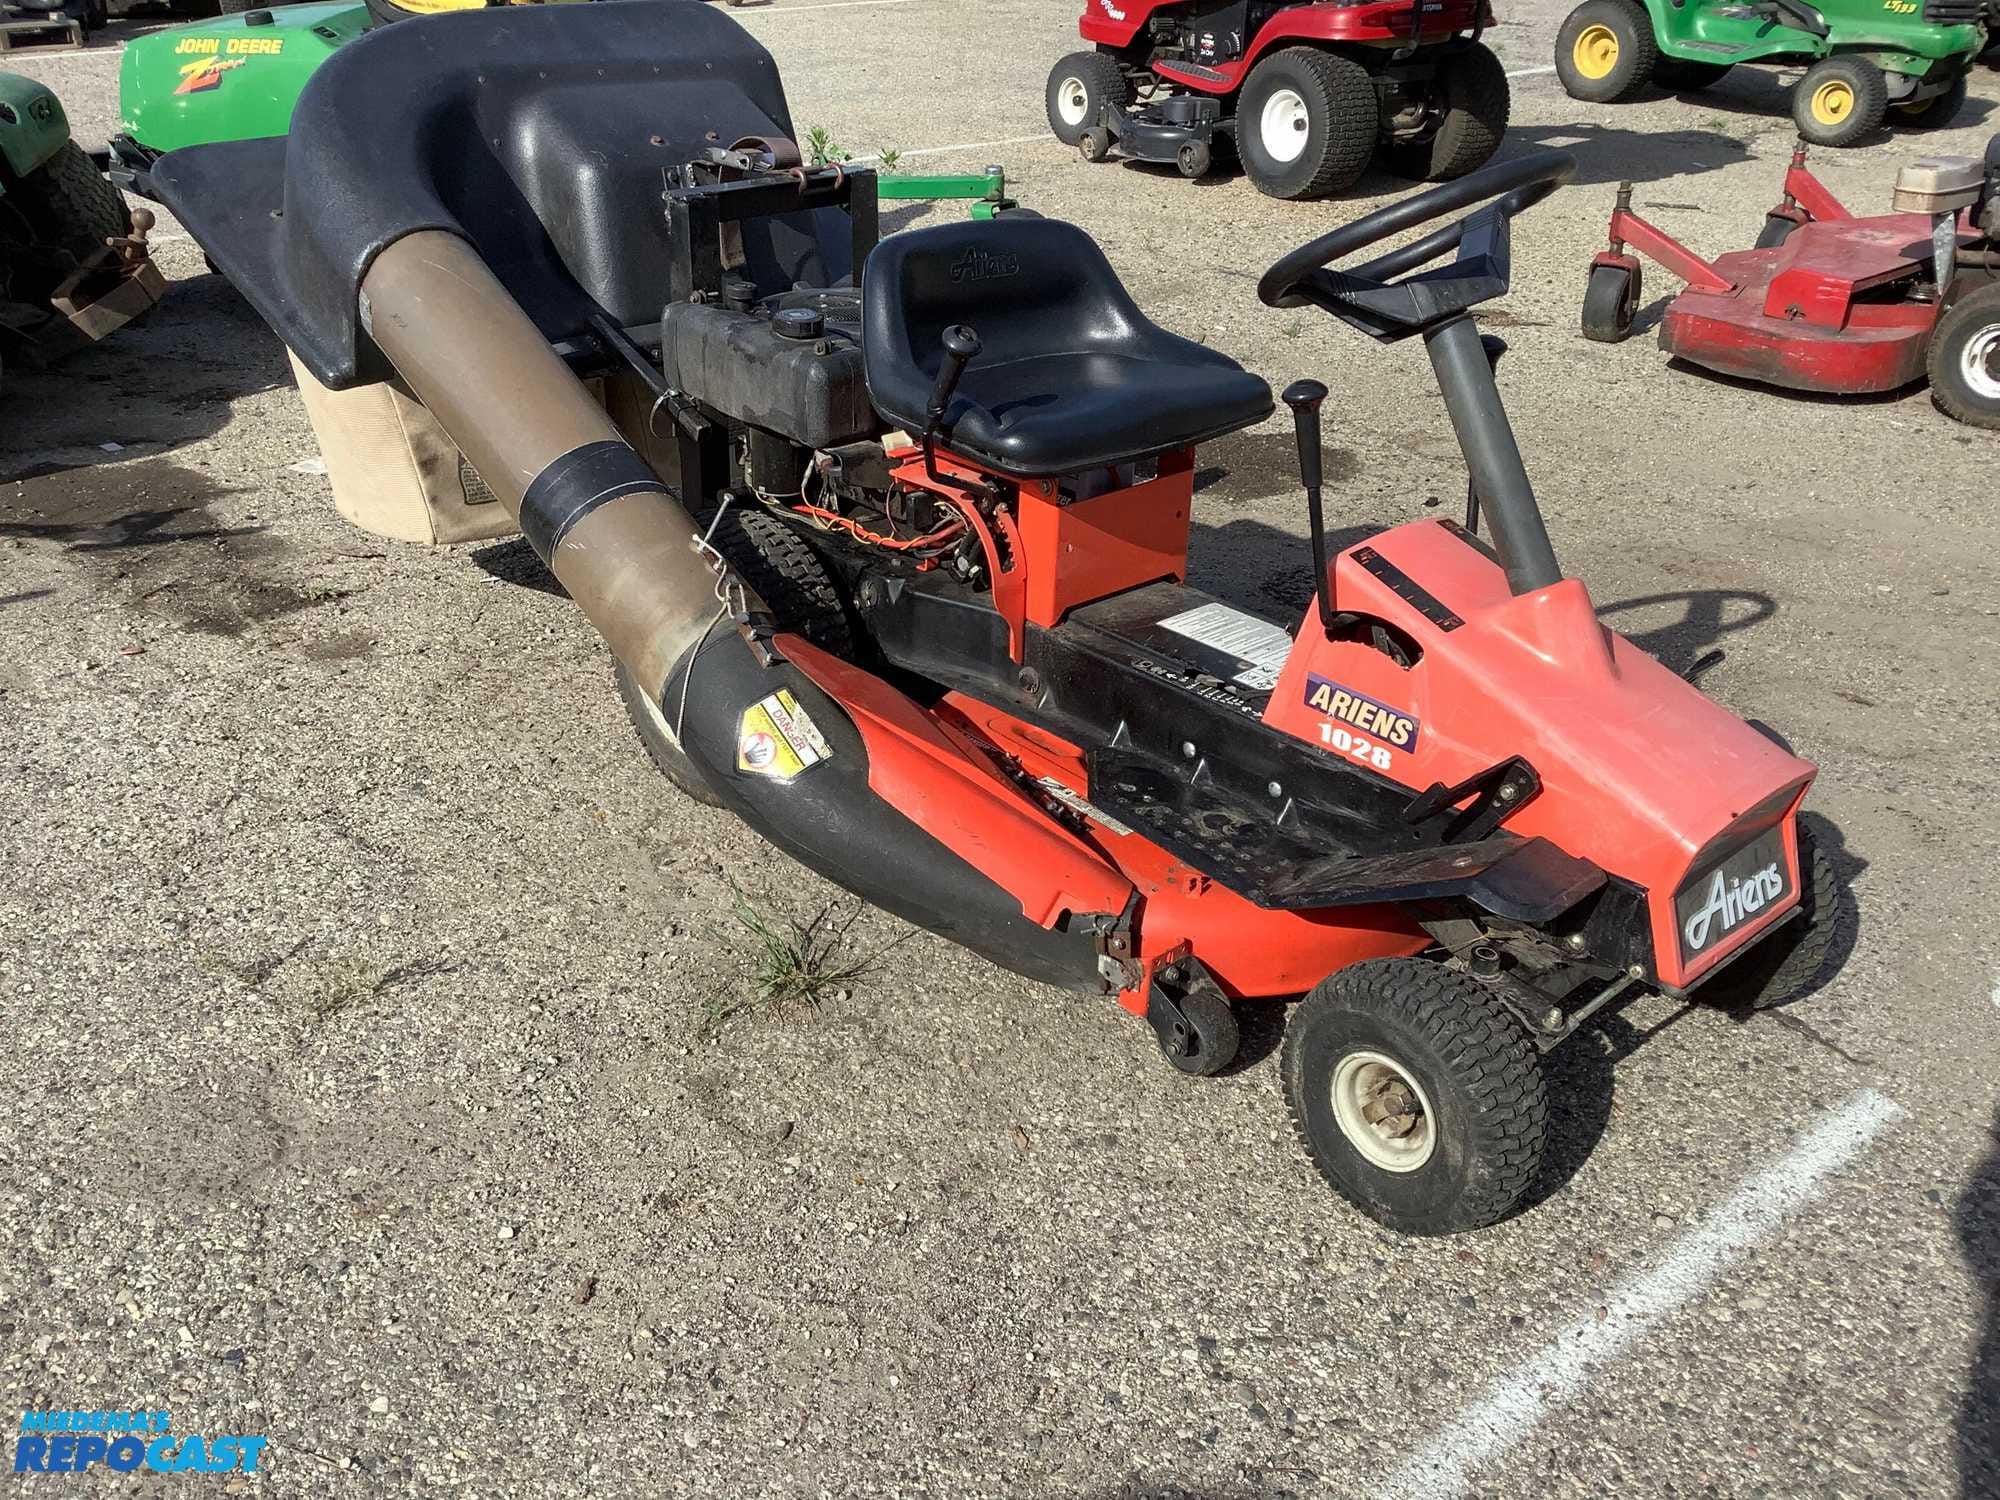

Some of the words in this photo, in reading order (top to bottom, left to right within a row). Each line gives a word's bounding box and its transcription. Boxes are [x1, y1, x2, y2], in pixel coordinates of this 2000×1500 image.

[175, 38, 219, 54] JOHN
[226, 38, 283, 54] DEERE
[1309, 683, 1413, 745] ARIENS
[1317, 722, 1392, 770] 1028
[1685, 862, 1782, 950] Ariens
